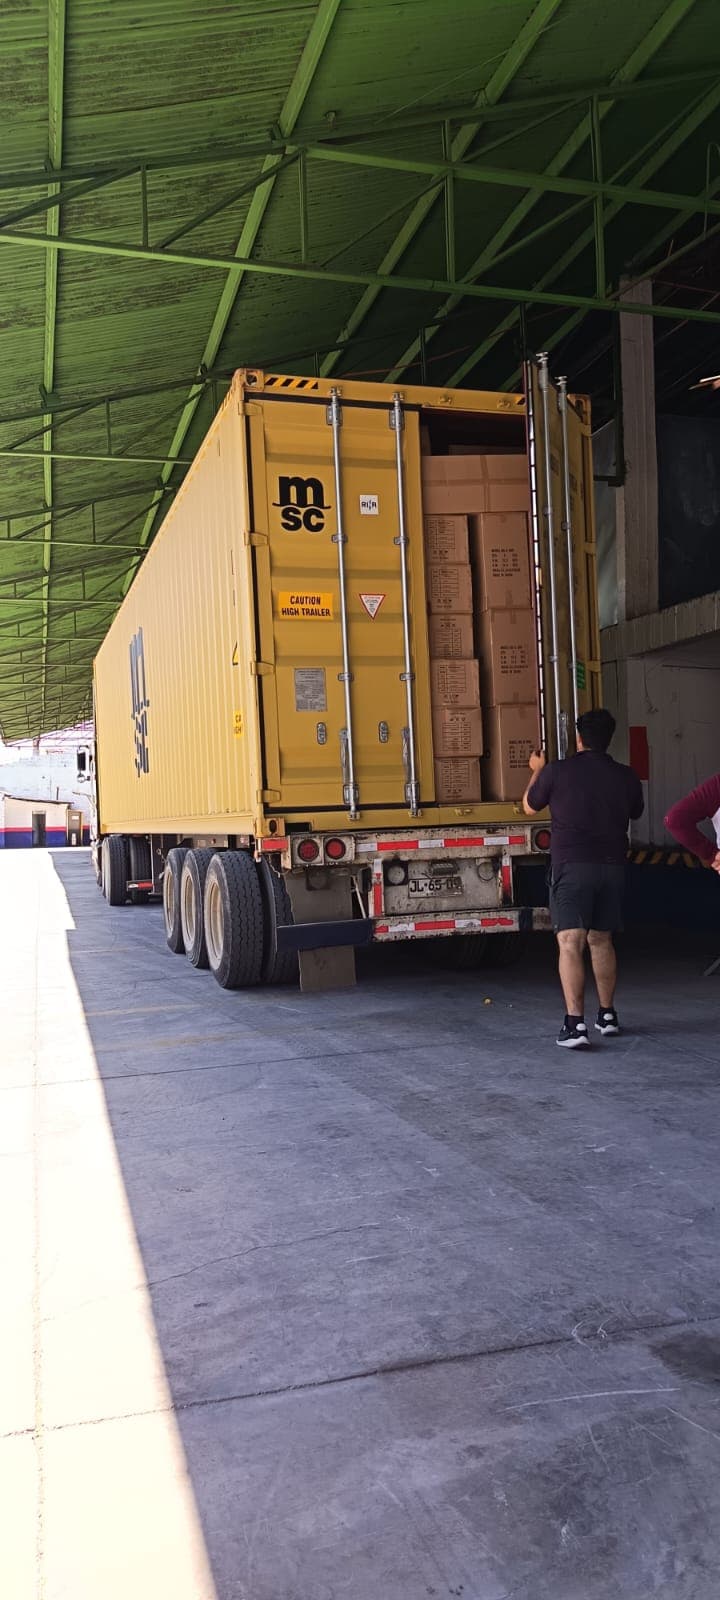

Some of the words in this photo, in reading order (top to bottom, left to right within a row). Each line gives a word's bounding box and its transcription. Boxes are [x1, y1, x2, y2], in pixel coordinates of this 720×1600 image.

[290, 595, 321, 605] CAUTION
[281, 607, 299, 616] HIGH
[302, 608, 331, 617] TRAILER
